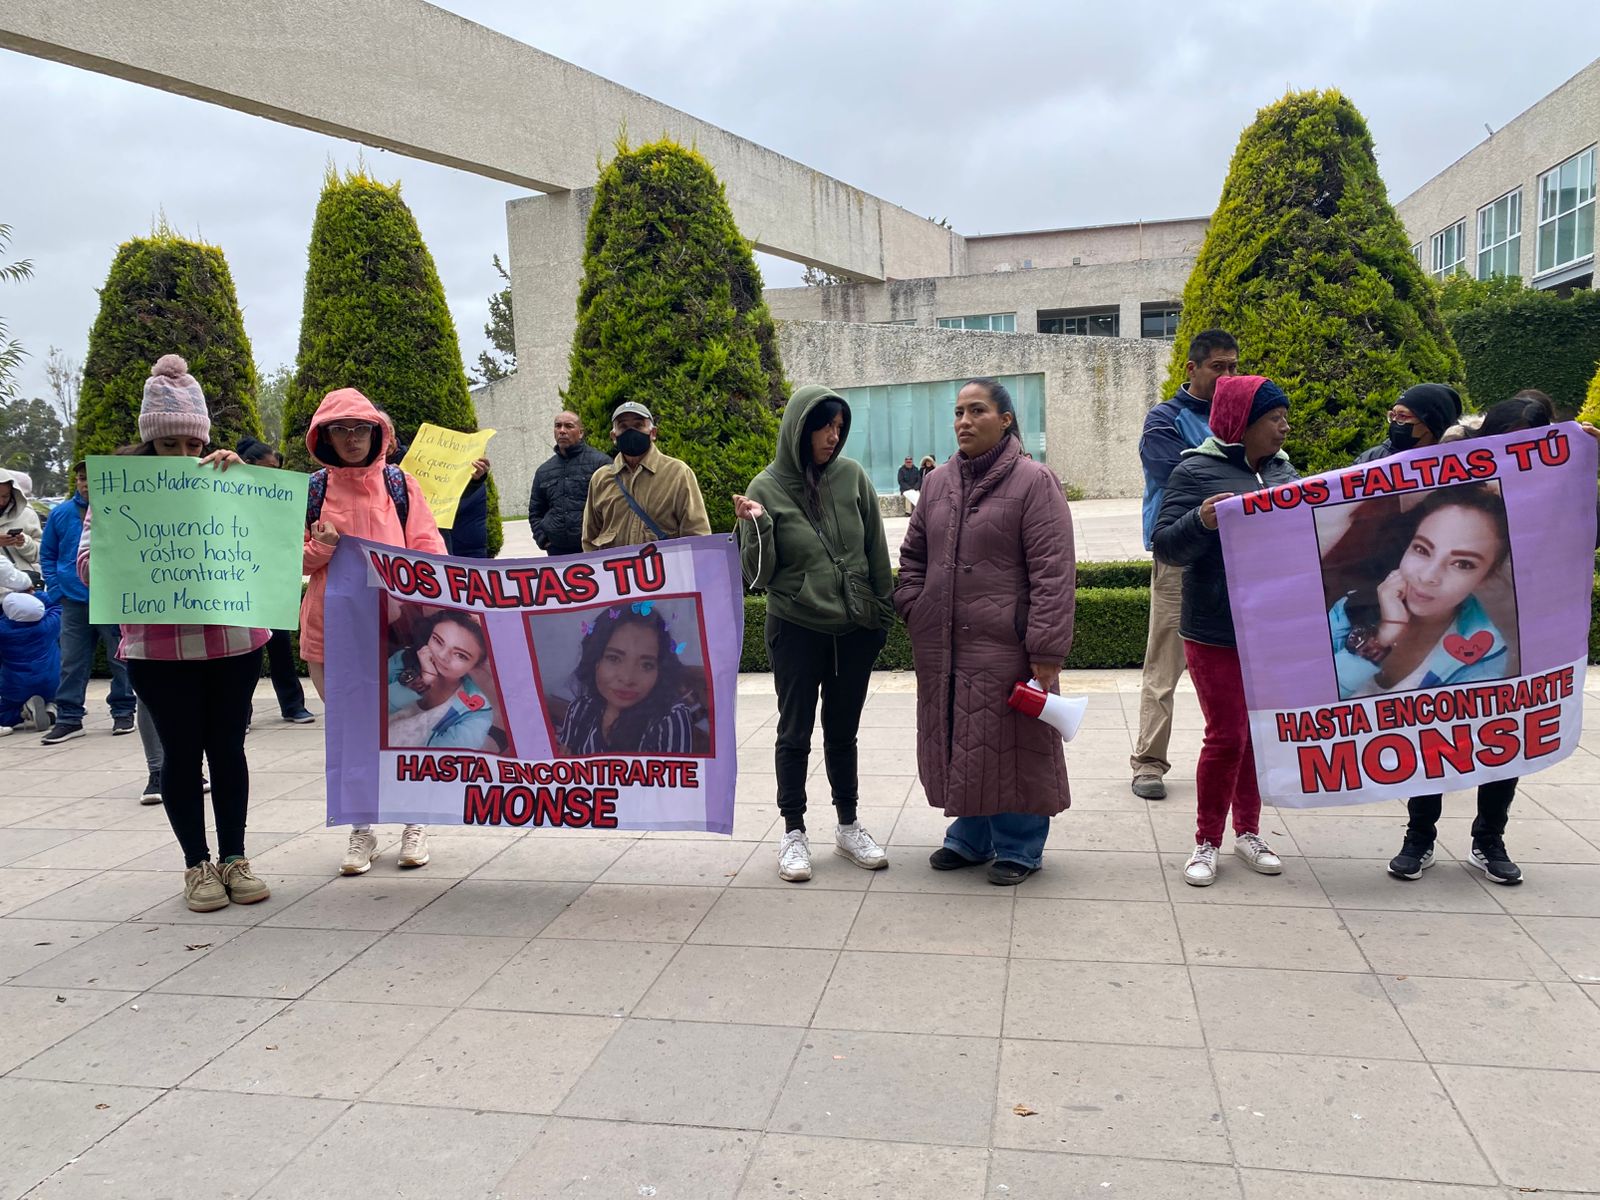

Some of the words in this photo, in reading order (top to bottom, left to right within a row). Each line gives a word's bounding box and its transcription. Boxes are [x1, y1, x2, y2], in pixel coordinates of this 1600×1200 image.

[1241, 477, 1331, 516] NOS
[1340, 448, 1497, 500] FALTAS
[1506, 430, 1571, 472] TÚ
[231, 515, 249, 538] tu
[140, 540, 195, 563] rastro
[204, 540, 252, 563] hasta
[369, 551, 442, 598] NOS
[444, 563, 600, 608] FALTAS
[603, 543, 666, 595] TÚ
[121, 592, 166, 615] Elena
[173, 588, 253, 612] Moncerrat
[1275, 703, 1372, 742] HASTA
[1375, 666, 1575, 731] ENCONTRARTE
[396, 754, 493, 783] HASTA
[497, 759, 699, 788] ENCONTRARTE
[1297, 704, 1562, 794] MONSE
[463, 785, 619, 829] MONSE
